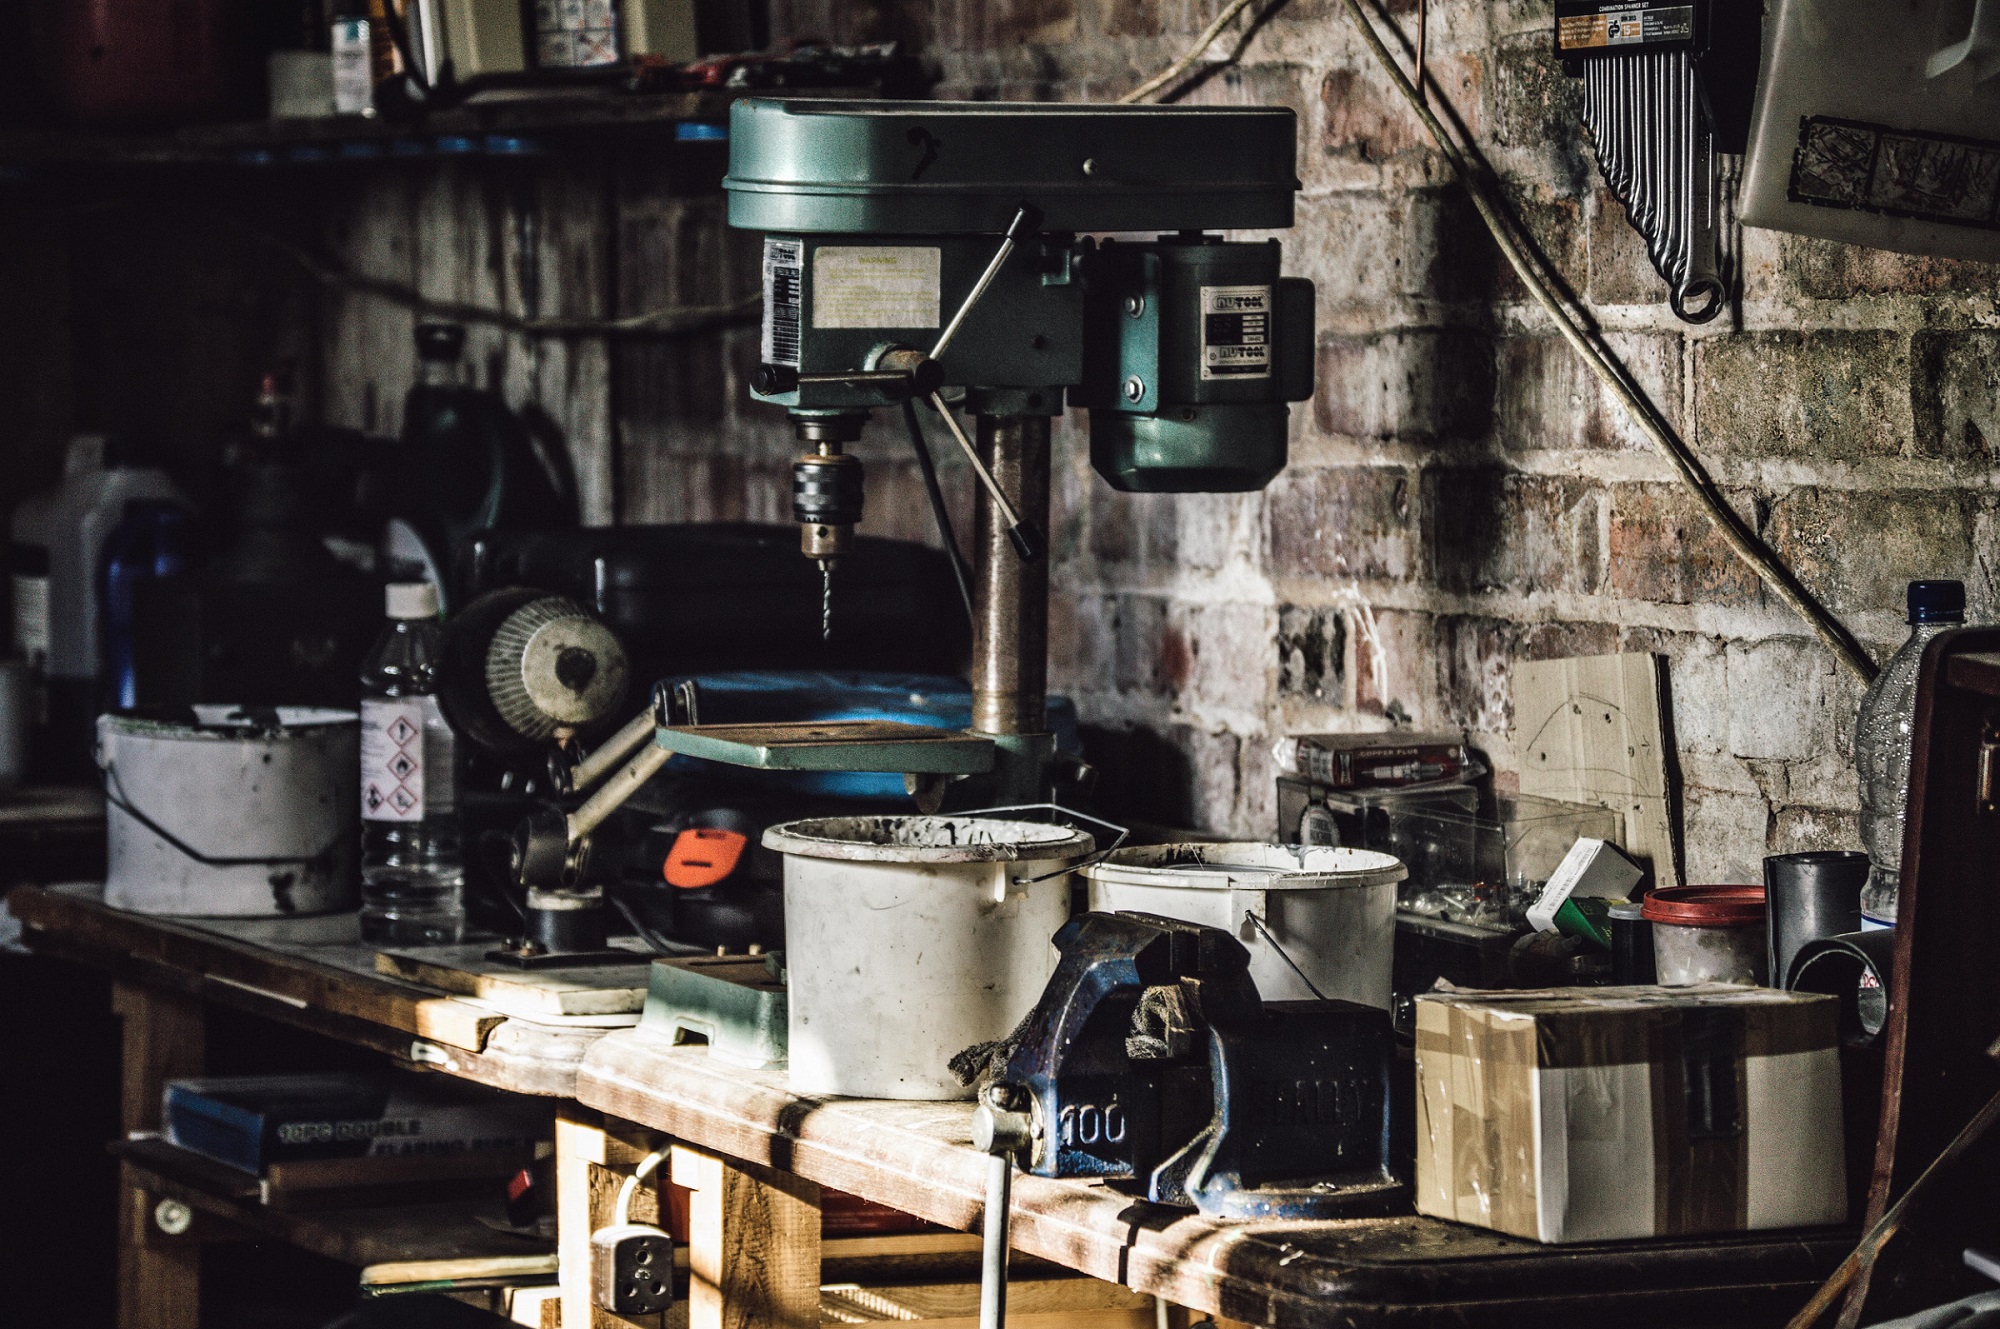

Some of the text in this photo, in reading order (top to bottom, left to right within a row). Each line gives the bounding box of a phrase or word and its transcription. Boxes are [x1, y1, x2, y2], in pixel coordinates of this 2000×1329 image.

[1598, 4, 1623, 12] COMBINATION
[1624, 2, 1641, 10] SPANNER
[1623, 24, 1631, 35] 15
[1359, 748, 1419, 758] COPPER PLUS
[335, 1119, 422, 1142] DOUBLE
[1060, 1103, 1126, 1147] 100
